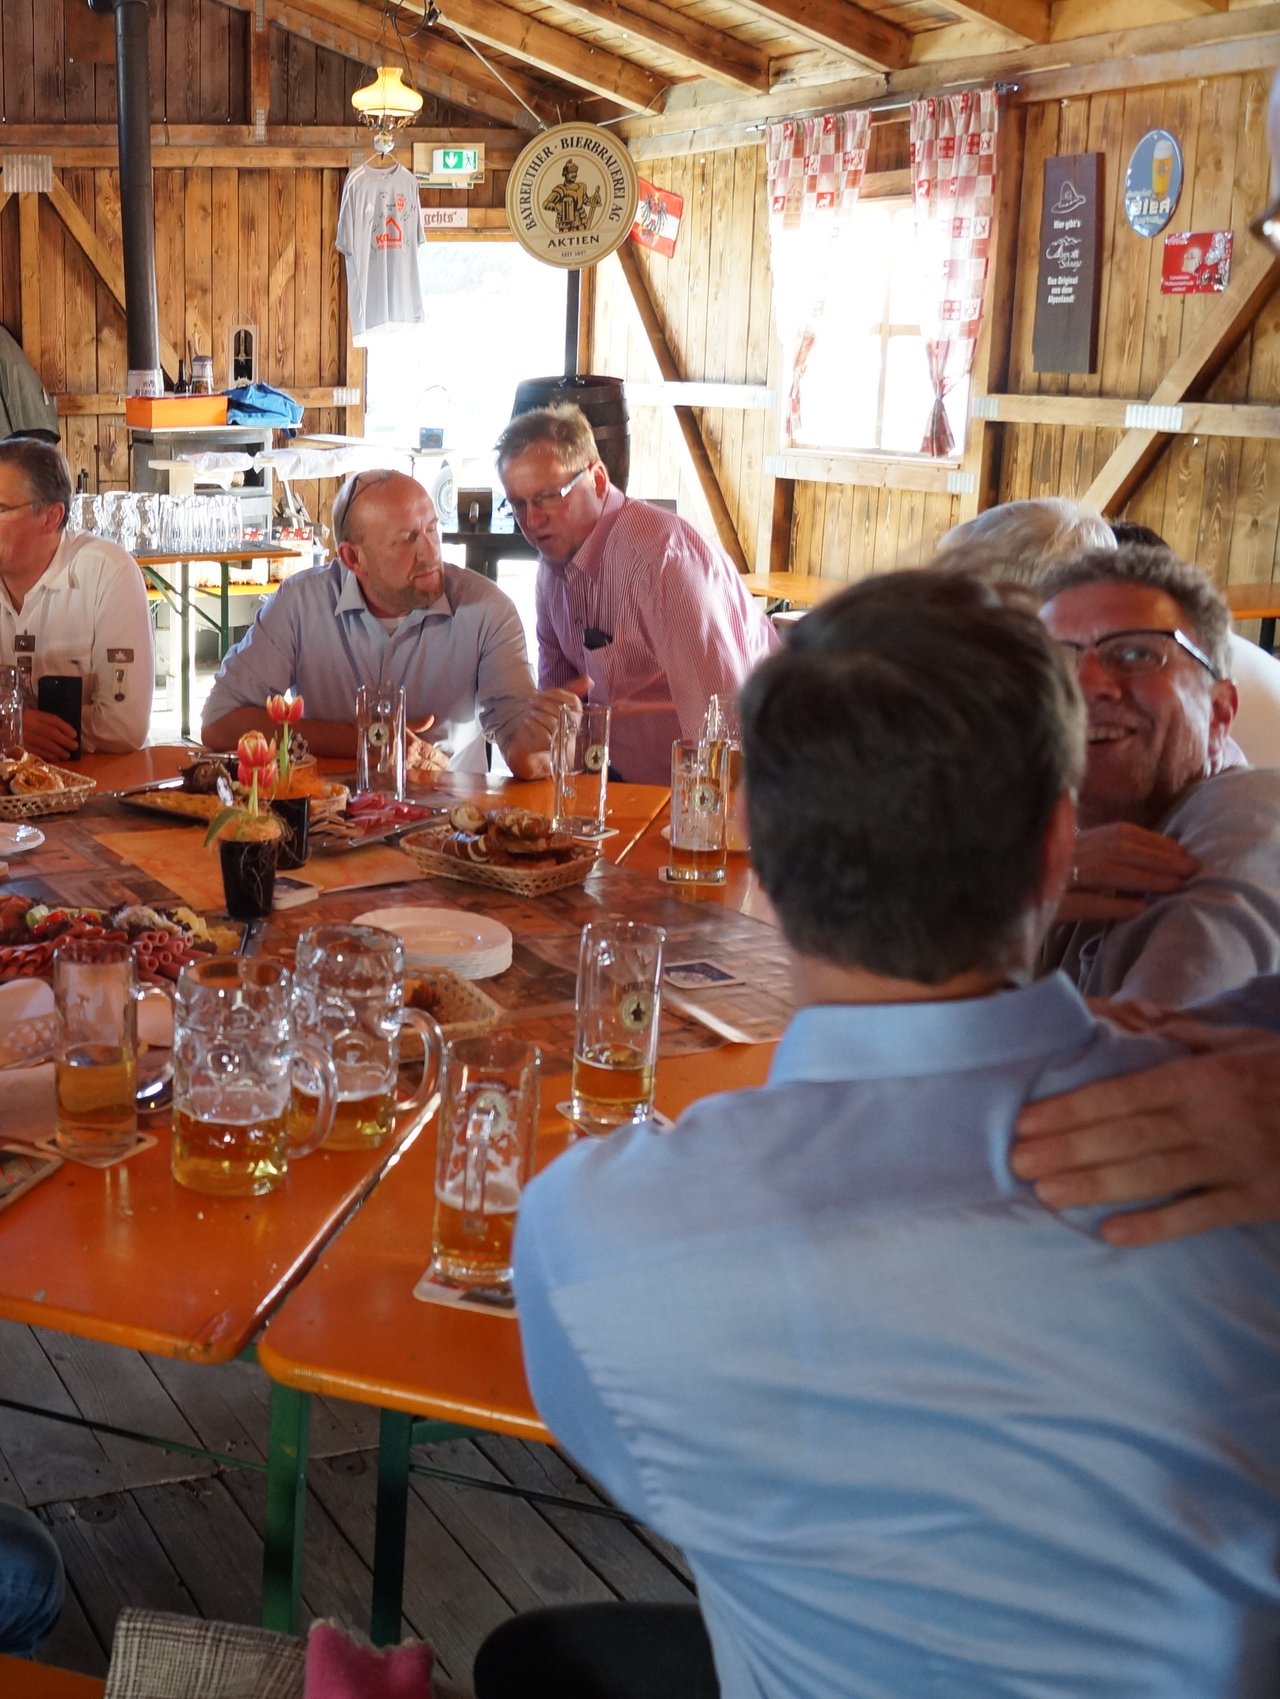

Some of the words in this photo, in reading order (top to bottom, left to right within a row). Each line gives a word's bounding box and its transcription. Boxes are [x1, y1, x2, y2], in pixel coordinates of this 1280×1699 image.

[520, 145, 554, 231] BAYREUTHER
[560, 136, 625, 199] BIERBRAUEREI
[609, 203, 623, 222] AG
[547, 234, 601, 248] AKTIEN
